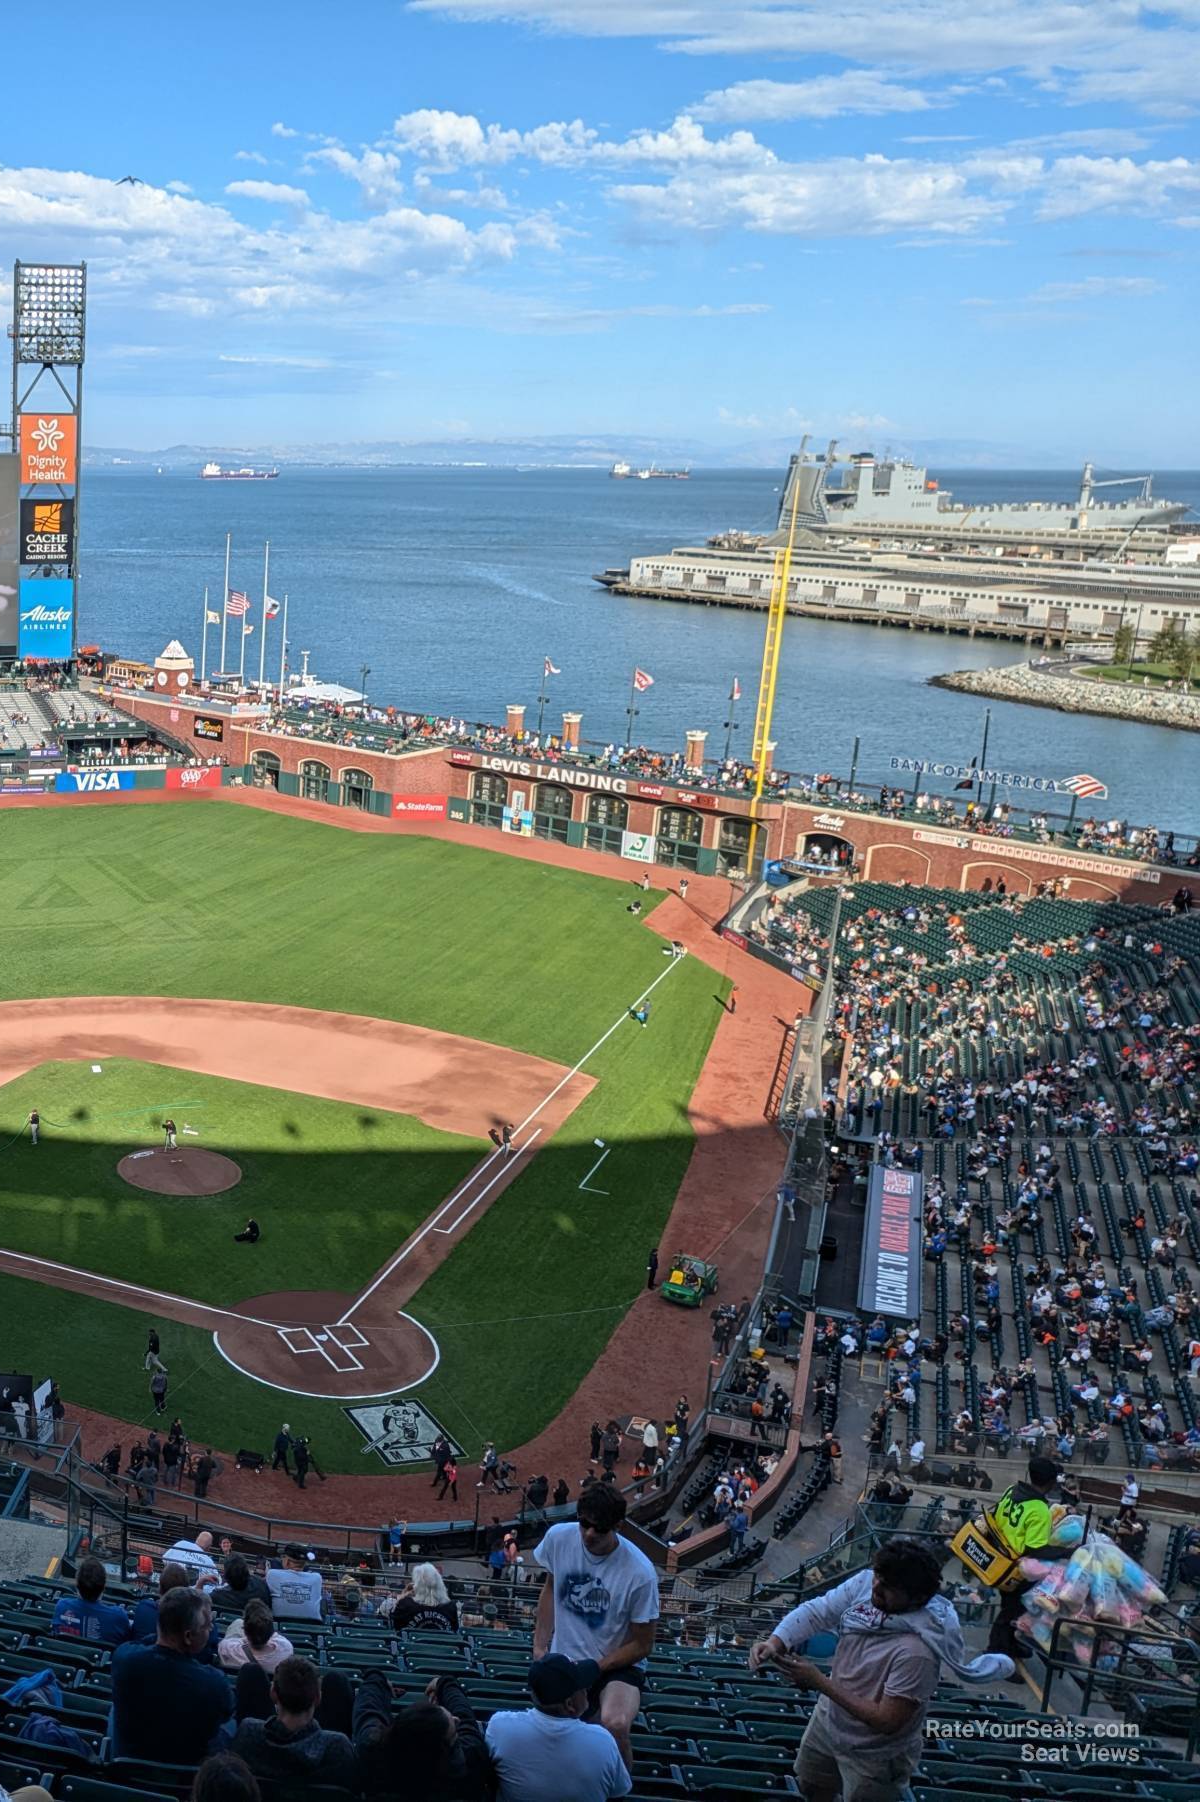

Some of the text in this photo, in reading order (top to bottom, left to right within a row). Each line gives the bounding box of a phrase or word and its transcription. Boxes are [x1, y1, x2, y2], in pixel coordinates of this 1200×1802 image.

[28, 455, 67, 469] Dignity
[30, 469, 65, 480] Health
[26, 534, 68, 543] CACHE
[27, 544, 66, 553] CREEK
[20, 605, 72, 622] Alaska
[80, 757, 115, 766] WELCOME
[120, 757, 129, 765] TO
[72, 773, 120, 791] VISA
[181, 769, 201, 783] AAA
[537, 764, 627, 793] LANDING
[891, 757, 1057, 792] BANK OF AMERICA
[451, 810, 464, 820] 365
[811, 813, 846, 827] Alaska
[880, 1193, 911, 1218] PARK
[879, 1217, 910, 1253] ORACLE
[875, 1252, 909, 1314] WELCOME TO
[966, 1538, 990, 1562] Minute
[966, 1546, 984, 1566] Maid
